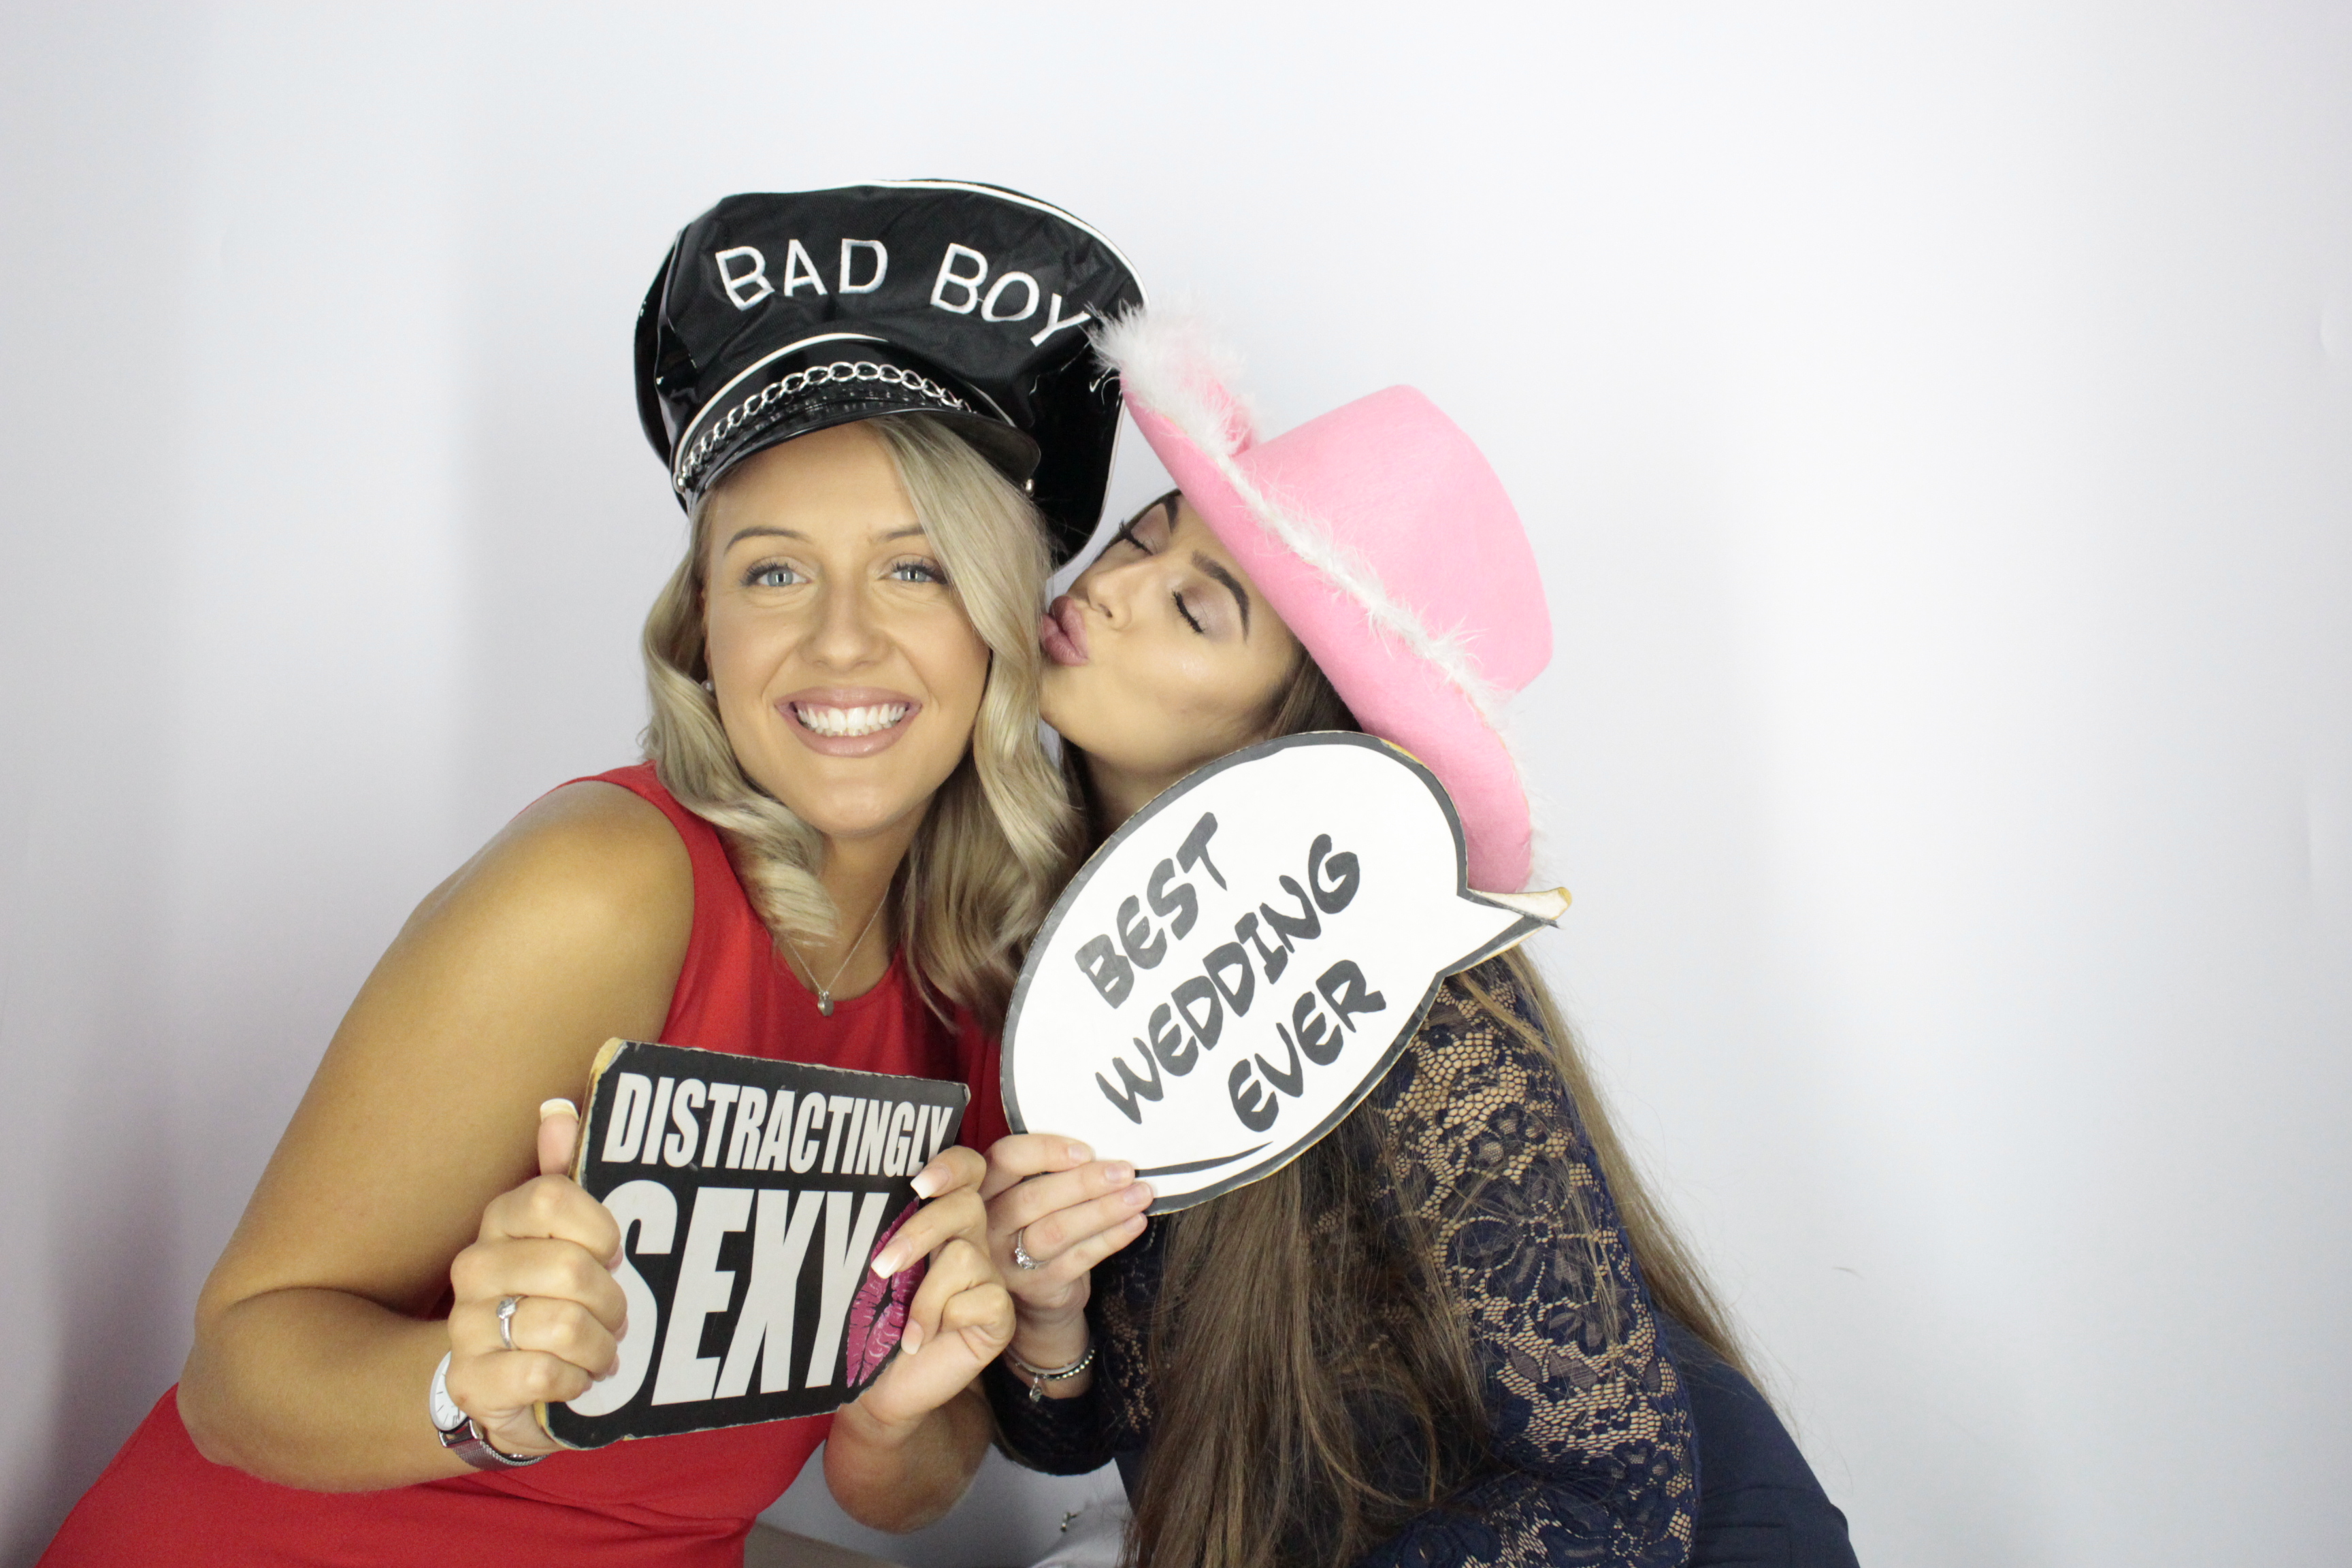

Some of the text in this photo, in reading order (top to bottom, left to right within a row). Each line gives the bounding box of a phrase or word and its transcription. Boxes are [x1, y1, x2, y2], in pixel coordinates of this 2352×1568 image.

[715, 238, 1091, 347] BAD BOY
[1075, 811, 1227, 1009] BEST
[1094, 833, 1360, 1124] WEDDING
[602, 1072, 953, 1177] DISTRACTINGLY
[1228, 960, 1386, 1132] EVER
[566, 1179, 889, 1416] SEXY
